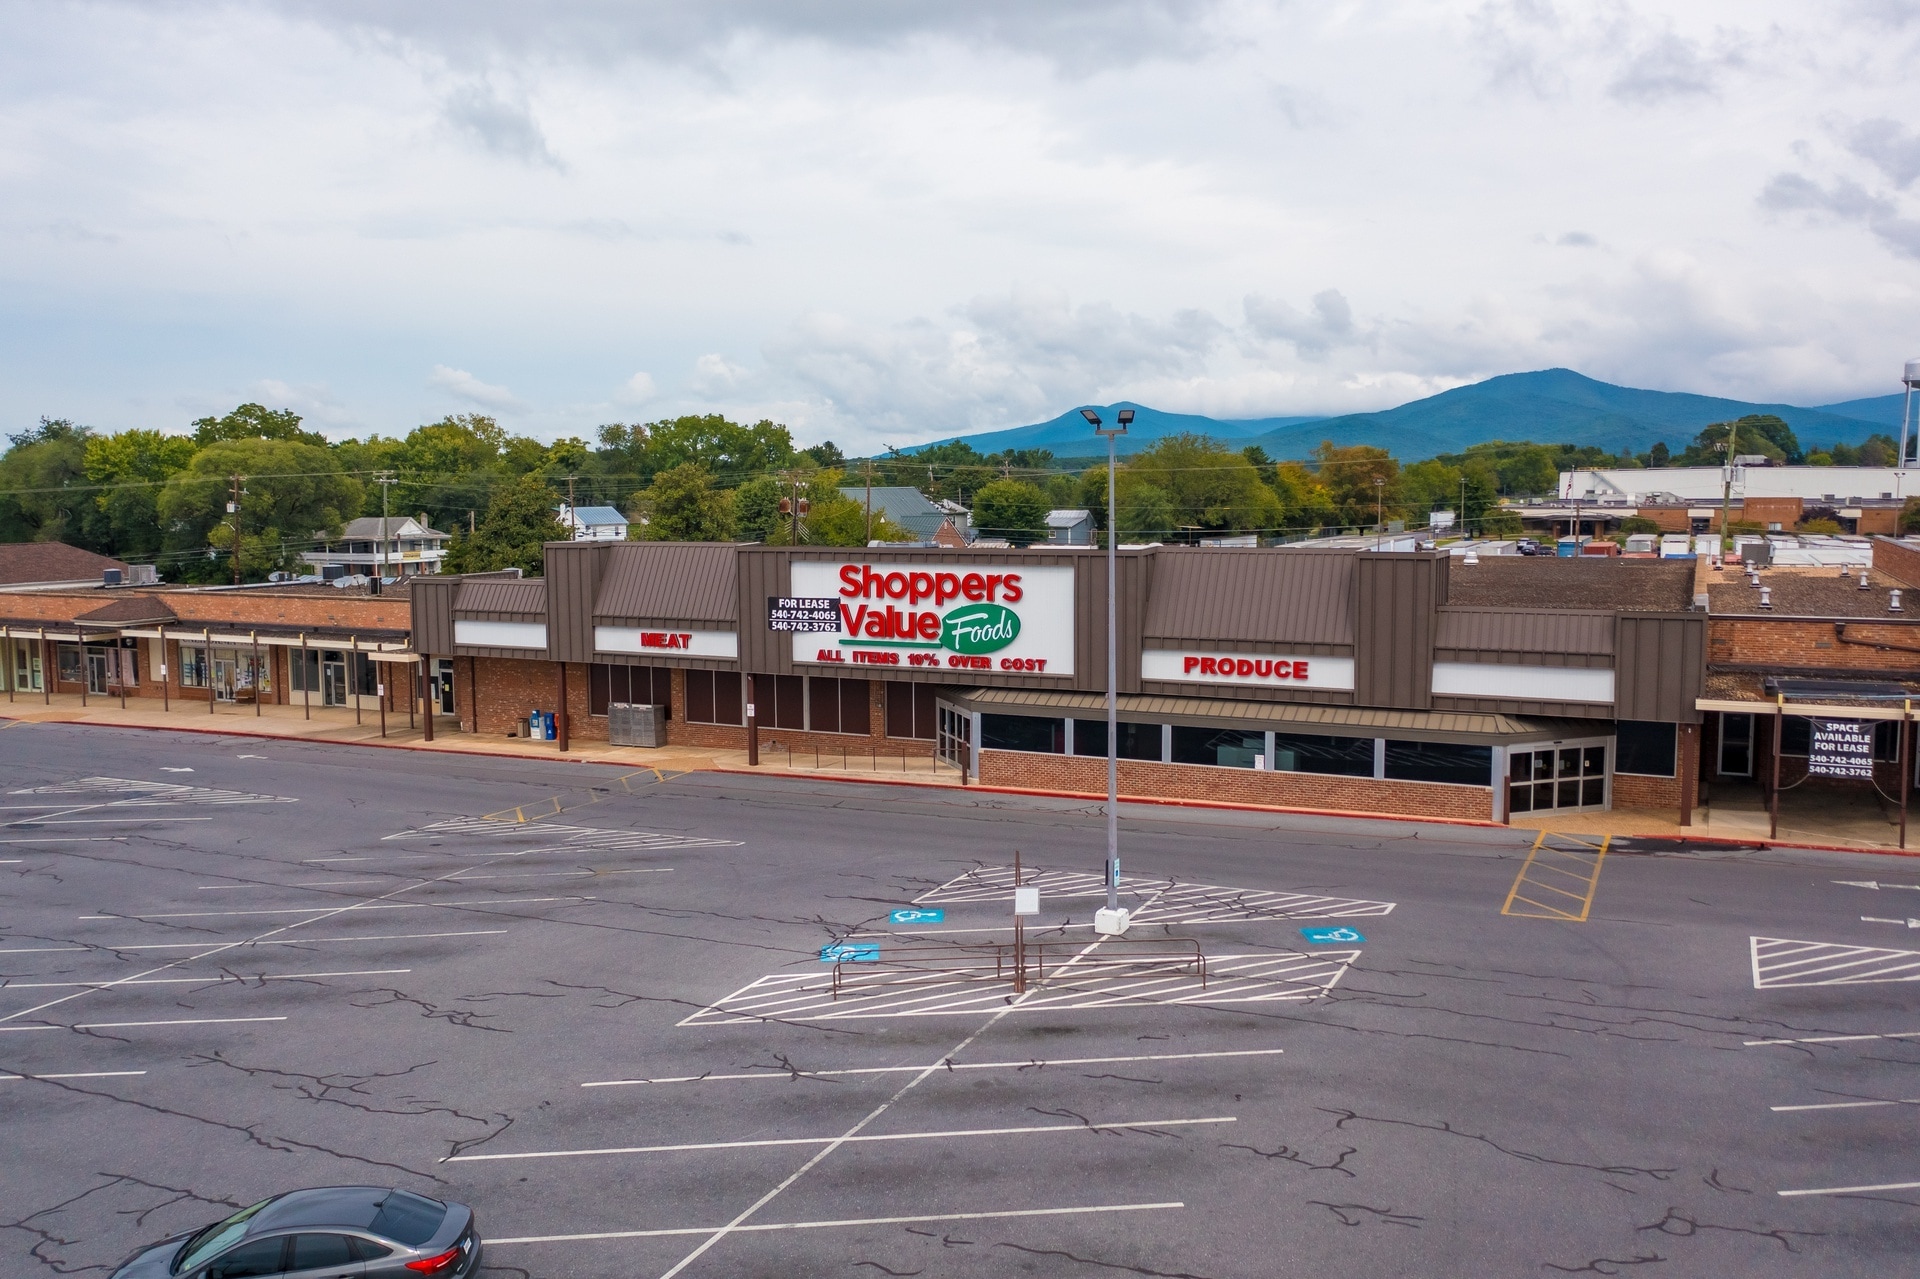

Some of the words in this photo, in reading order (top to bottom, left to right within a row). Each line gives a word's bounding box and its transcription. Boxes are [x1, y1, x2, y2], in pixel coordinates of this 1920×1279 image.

[839, 565, 1022, 606] Shoppers
[778, 598, 797, 608] FOR
[799, 599, 830, 609] LEASE
[771, 610, 837, 621] 540-742-4065
[771, 621, 837, 632] 540-742-3762
[839, 604, 940, 639] Value
[946, 609, 1013, 649] Foods
[641, 632, 692, 649] MEAT
[816, 649, 845, 662] ALL
[852, 651, 900, 665] ITEMS
[907, 652, 940, 667] 10%
[948, 655, 992, 669] OVER
[1000, 658, 1047, 672] COST
[1184, 657, 1308, 679] PRODUCE
[1826, 723, 1859, 733] SPACE
[1814, 732, 1871, 743] AVAILABLE
[1814, 742, 1836, 751] FOR
[1837, 743, 1869, 753] LEASE
[1809, 754, 1873, 765] 540-742-4065
[1809, 765, 1872, 777] 540-742-3762
